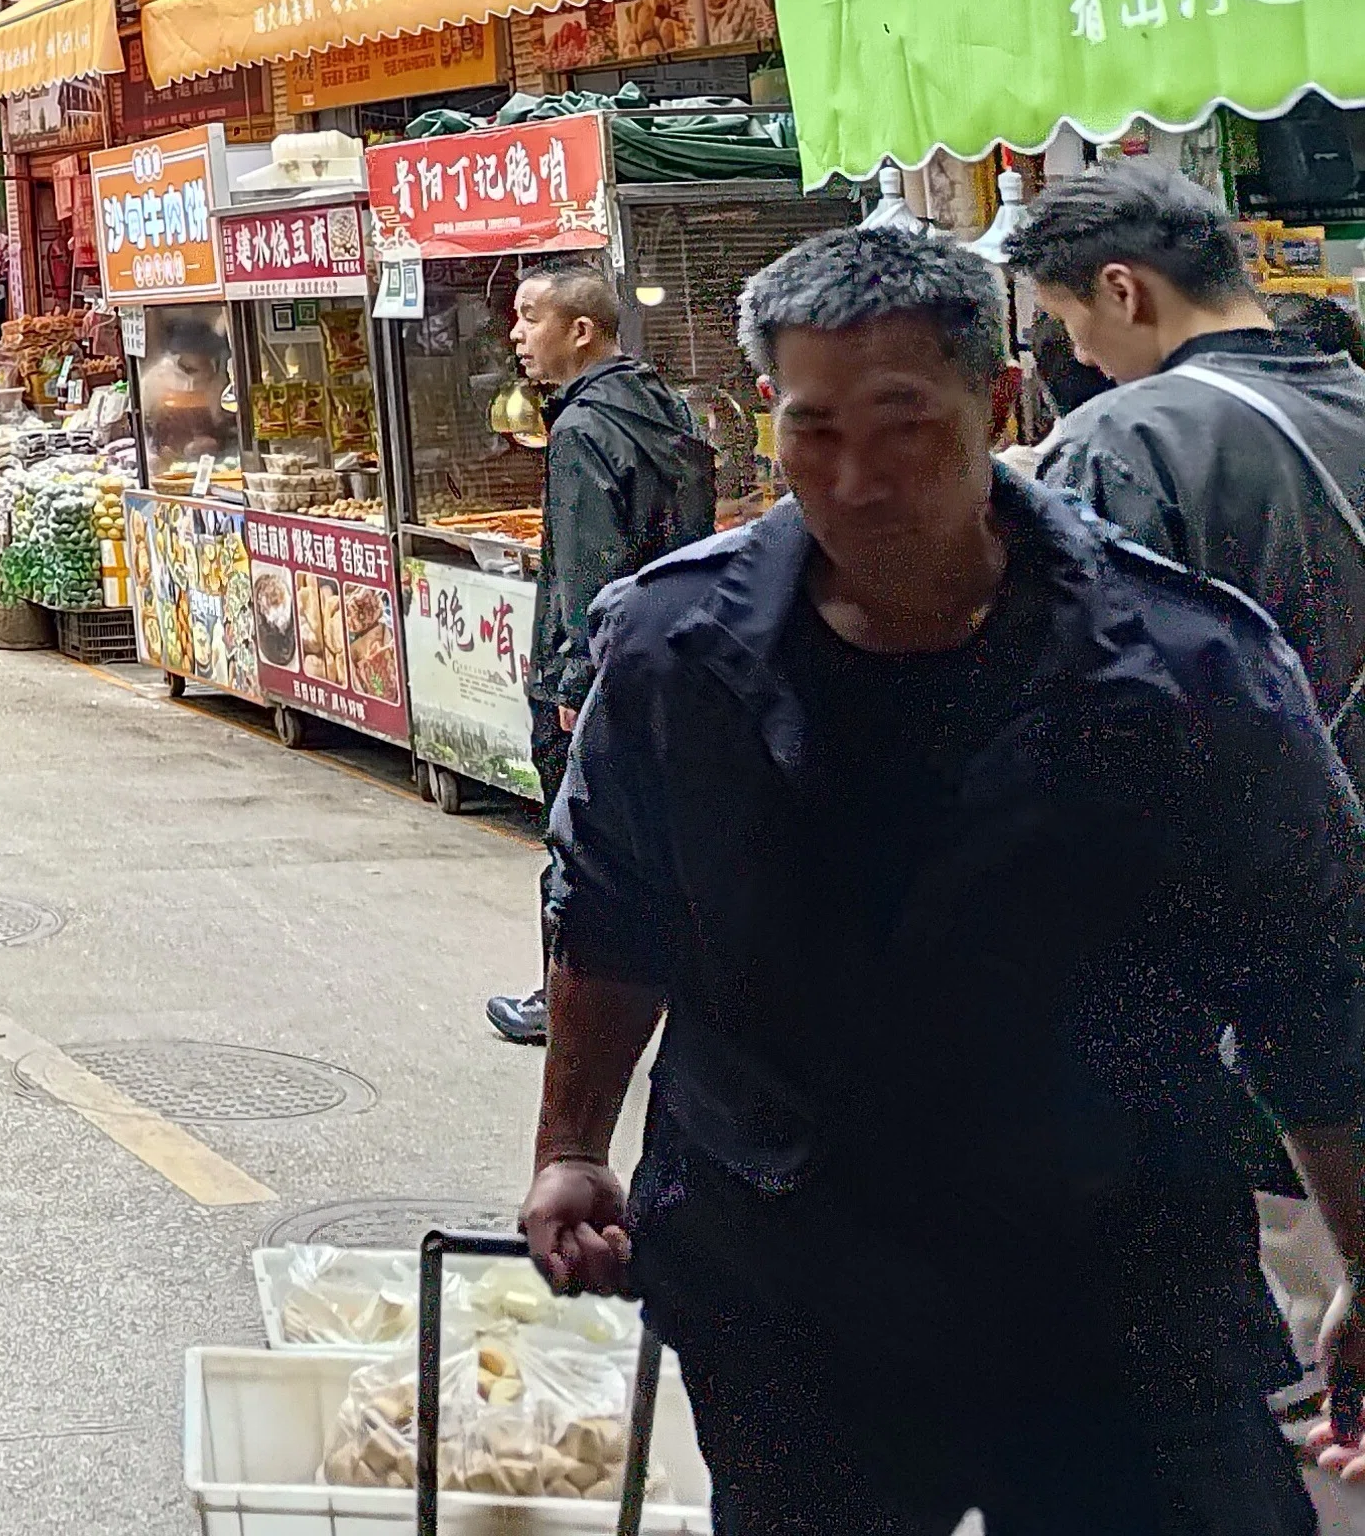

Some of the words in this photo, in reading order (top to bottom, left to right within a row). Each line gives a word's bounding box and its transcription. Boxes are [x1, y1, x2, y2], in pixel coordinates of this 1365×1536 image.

[103, 177, 209, 254] 沙甸牛肉饼
[391, 136, 569, 219] 贵阳丁记脆哨
[235, 216, 329, 273] 建水烧豆腐
